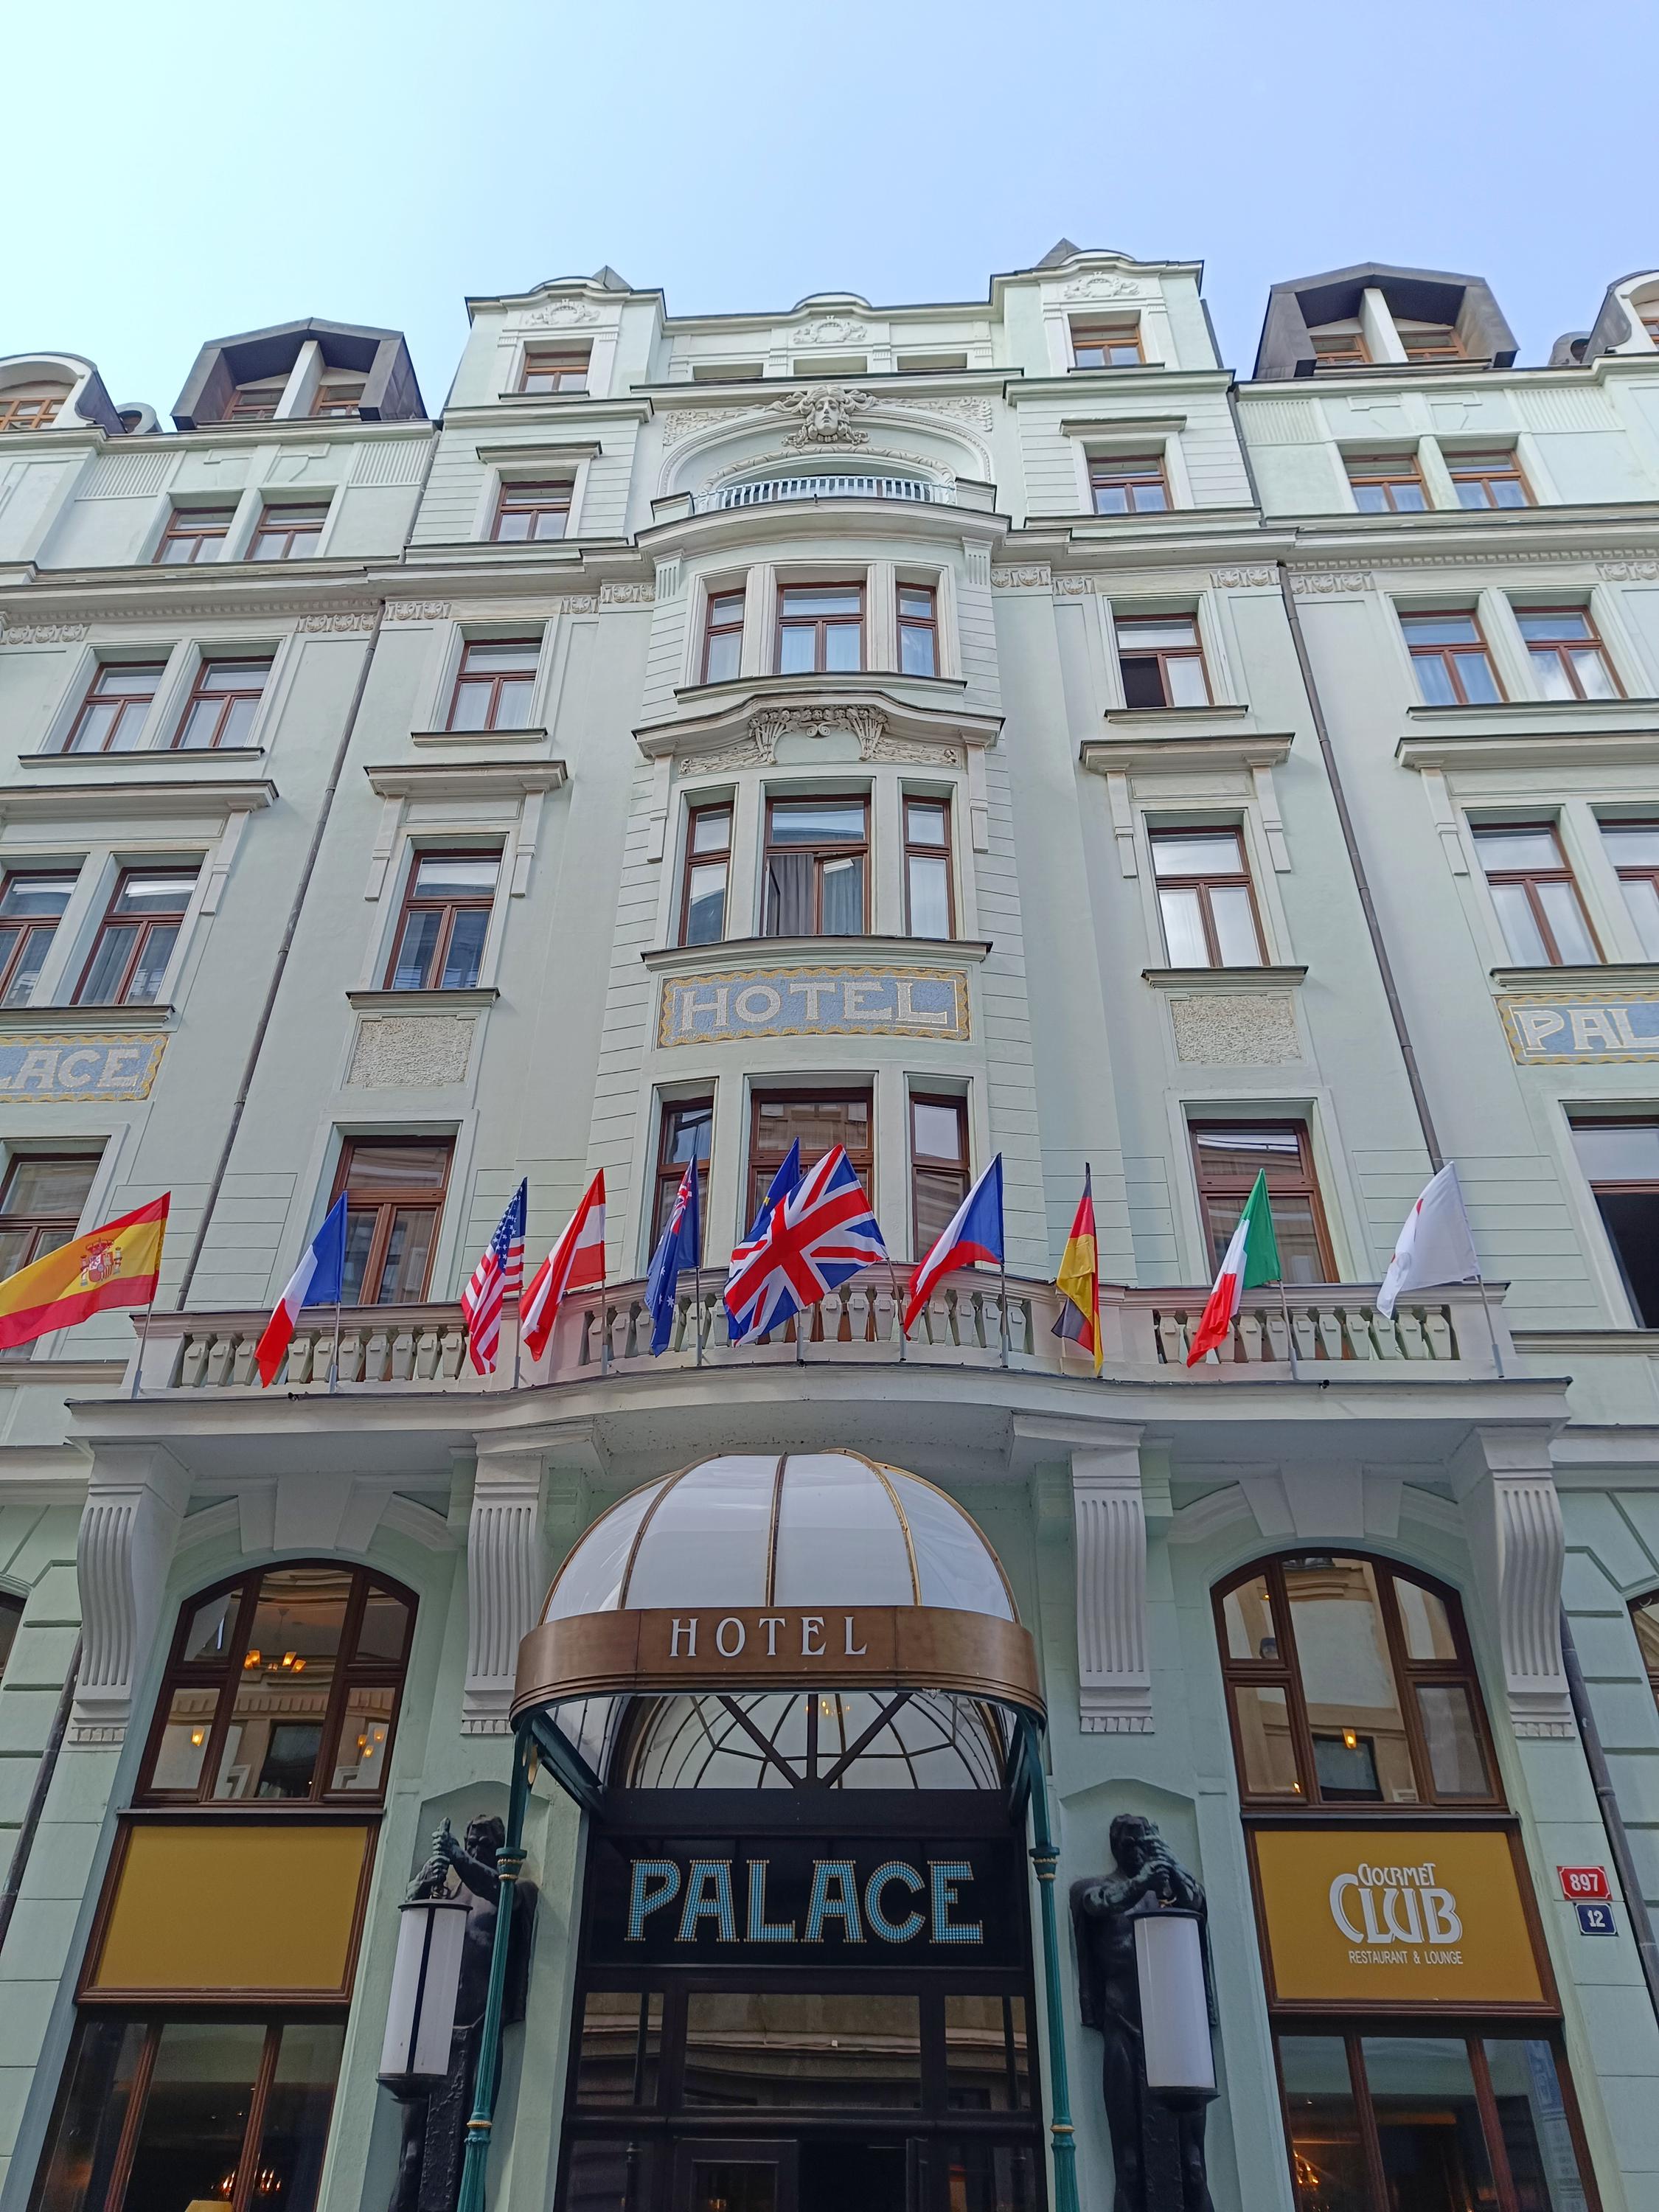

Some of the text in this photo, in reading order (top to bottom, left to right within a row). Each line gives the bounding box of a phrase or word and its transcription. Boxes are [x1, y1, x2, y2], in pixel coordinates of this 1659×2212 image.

[680, 981, 948, 1031] HOTEL
[1514, 1008, 1659, 1050] PAL
[0, 1048, 140, 1088] ACE
[669, 1616, 867, 1657] HOTEL
[1357, 1863, 1436, 1886] GOURMET
[1569, 1874, 1599, 1892] 897
[624, 1859, 984, 1944] PALACE
[1329, 1873, 1463, 1944] CLUB
[1587, 1910, 1606, 1927] 12
[1349, 1951, 1464, 1965] RESTAURANT & LOUNGE
